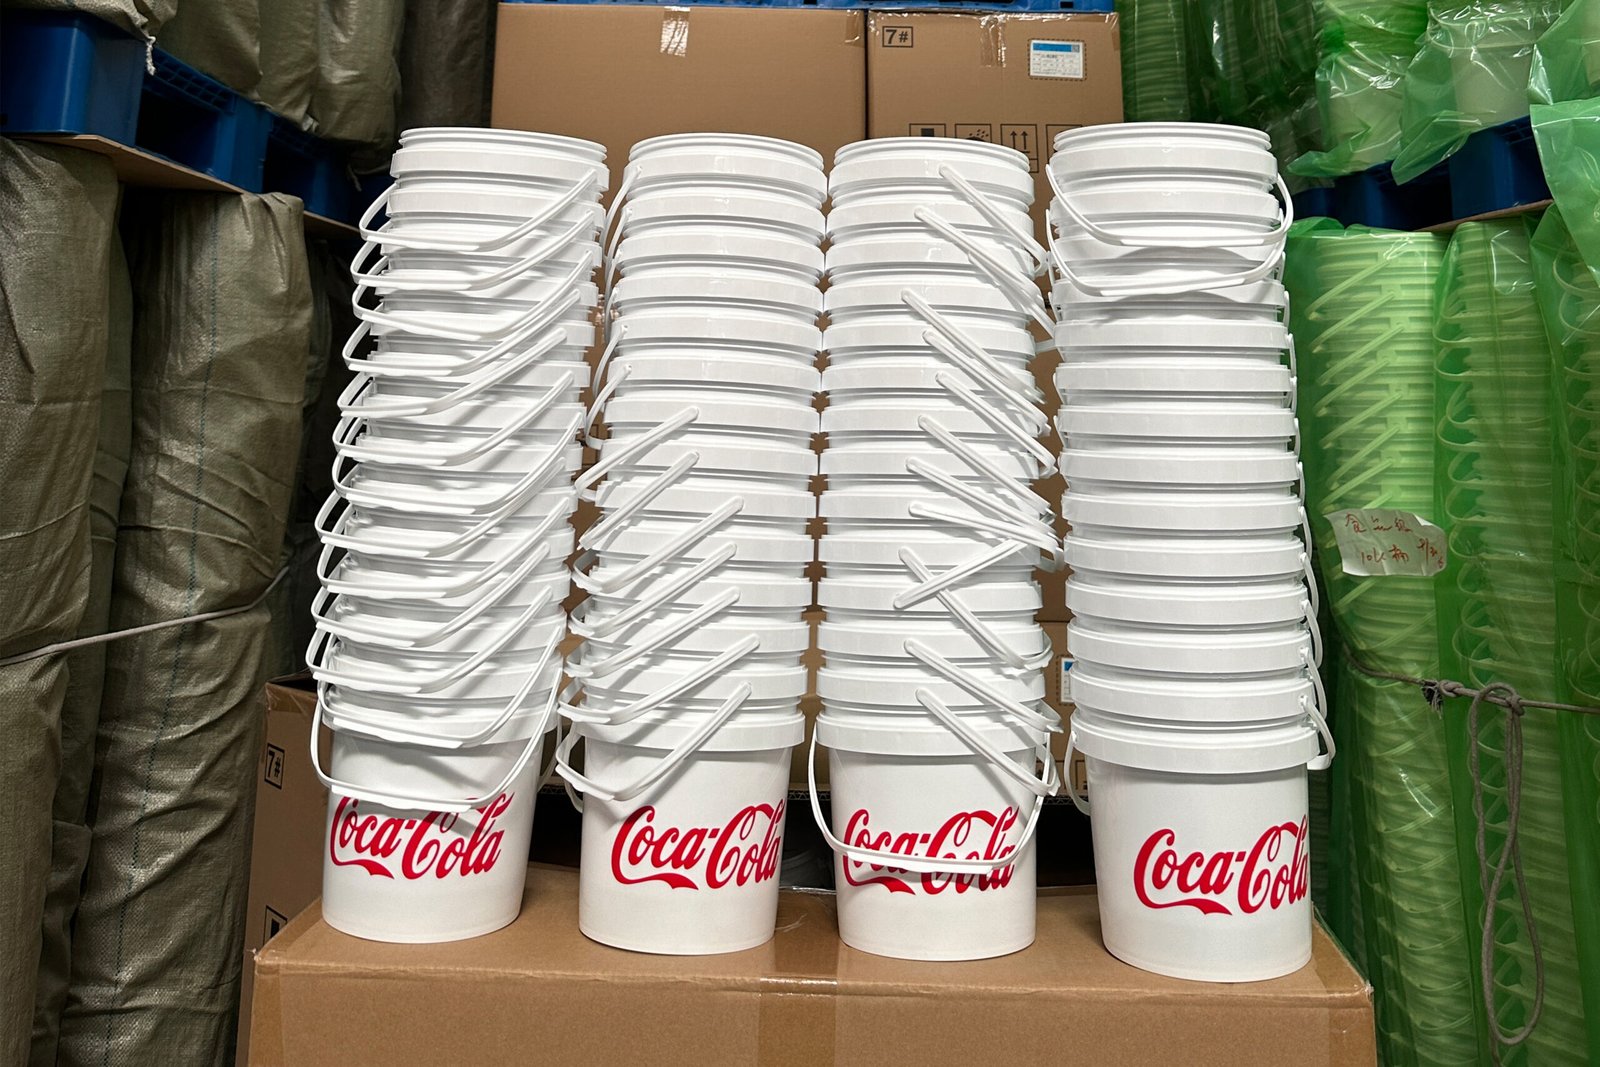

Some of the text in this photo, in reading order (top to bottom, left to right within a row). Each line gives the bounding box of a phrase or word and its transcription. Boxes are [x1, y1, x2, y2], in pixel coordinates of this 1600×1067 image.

[885, 29, 908, 44] 7#
[265, 750, 281, 778] 7#
[330, 792, 515, 880] Coca-Cola
[611, 799, 785, 890] Coca-Cola
[1133, 814, 1308, 916] Coca-Cola
